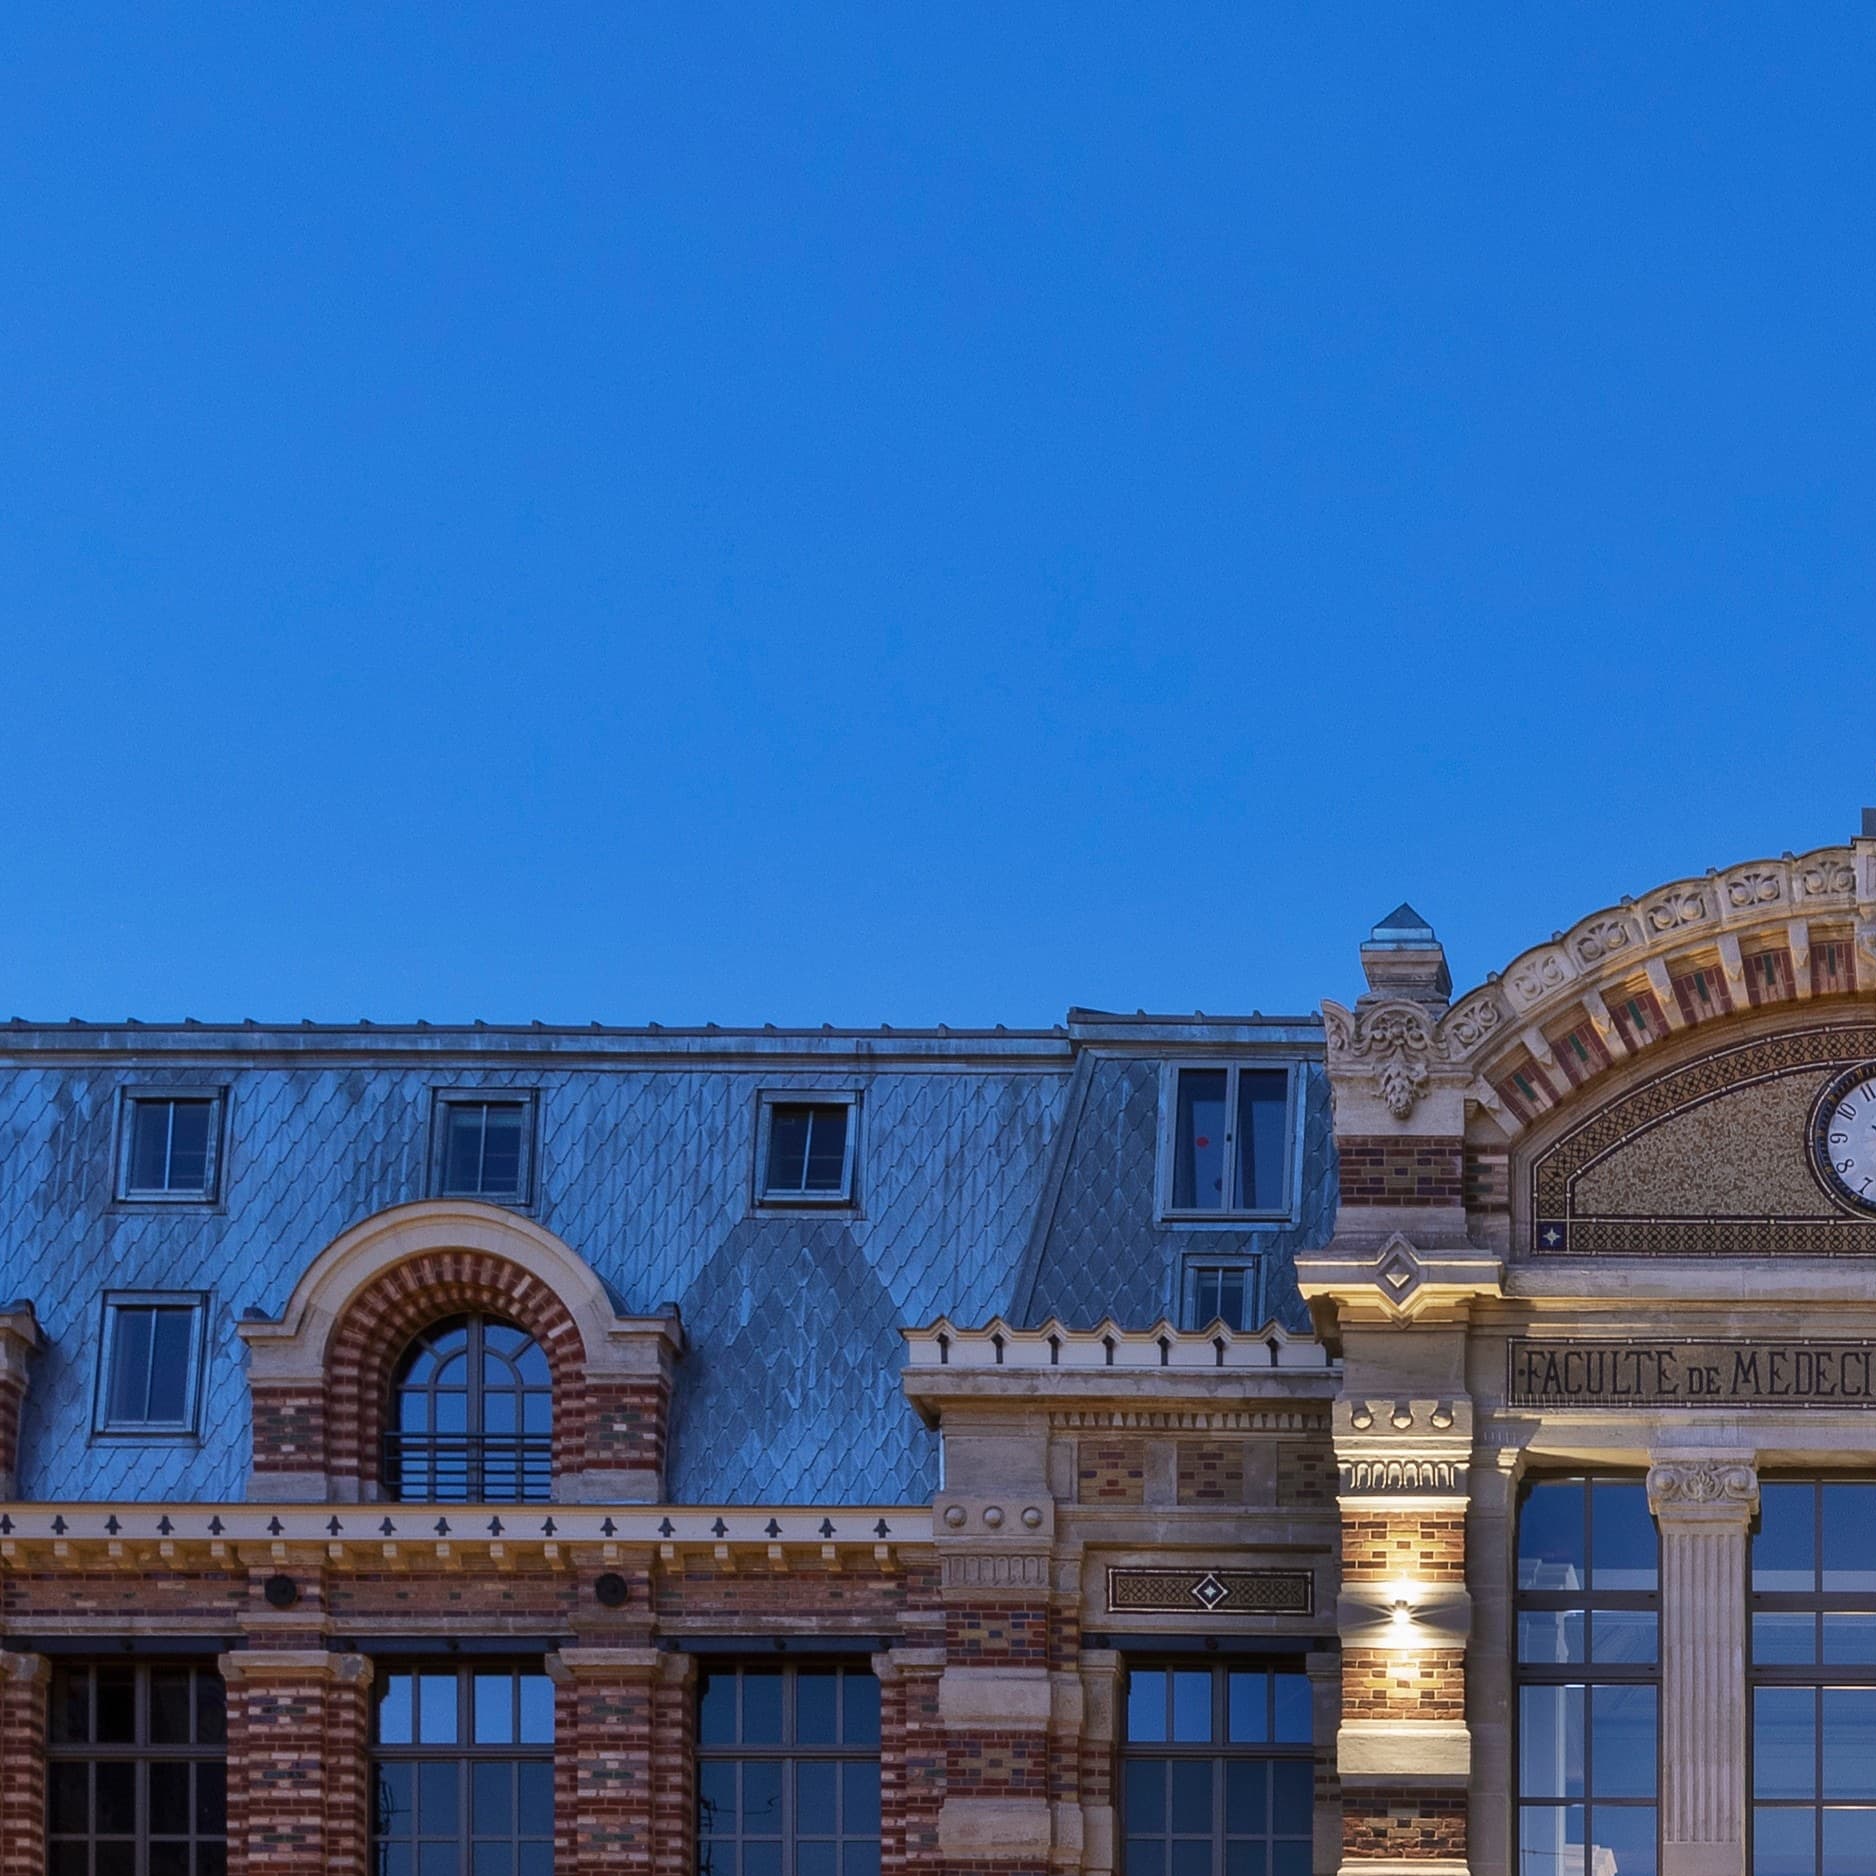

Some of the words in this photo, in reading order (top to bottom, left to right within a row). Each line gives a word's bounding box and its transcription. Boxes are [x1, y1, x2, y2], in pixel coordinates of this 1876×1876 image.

[1860, 1082, 1876, 1102] 11
[1837, 1102, 1857, 1121] 10
[1830, 1132, 1848, 1144] 9
[1836, 1158, 1855, 1174] 8
[1858, 1177, 1873, 1196] 7
